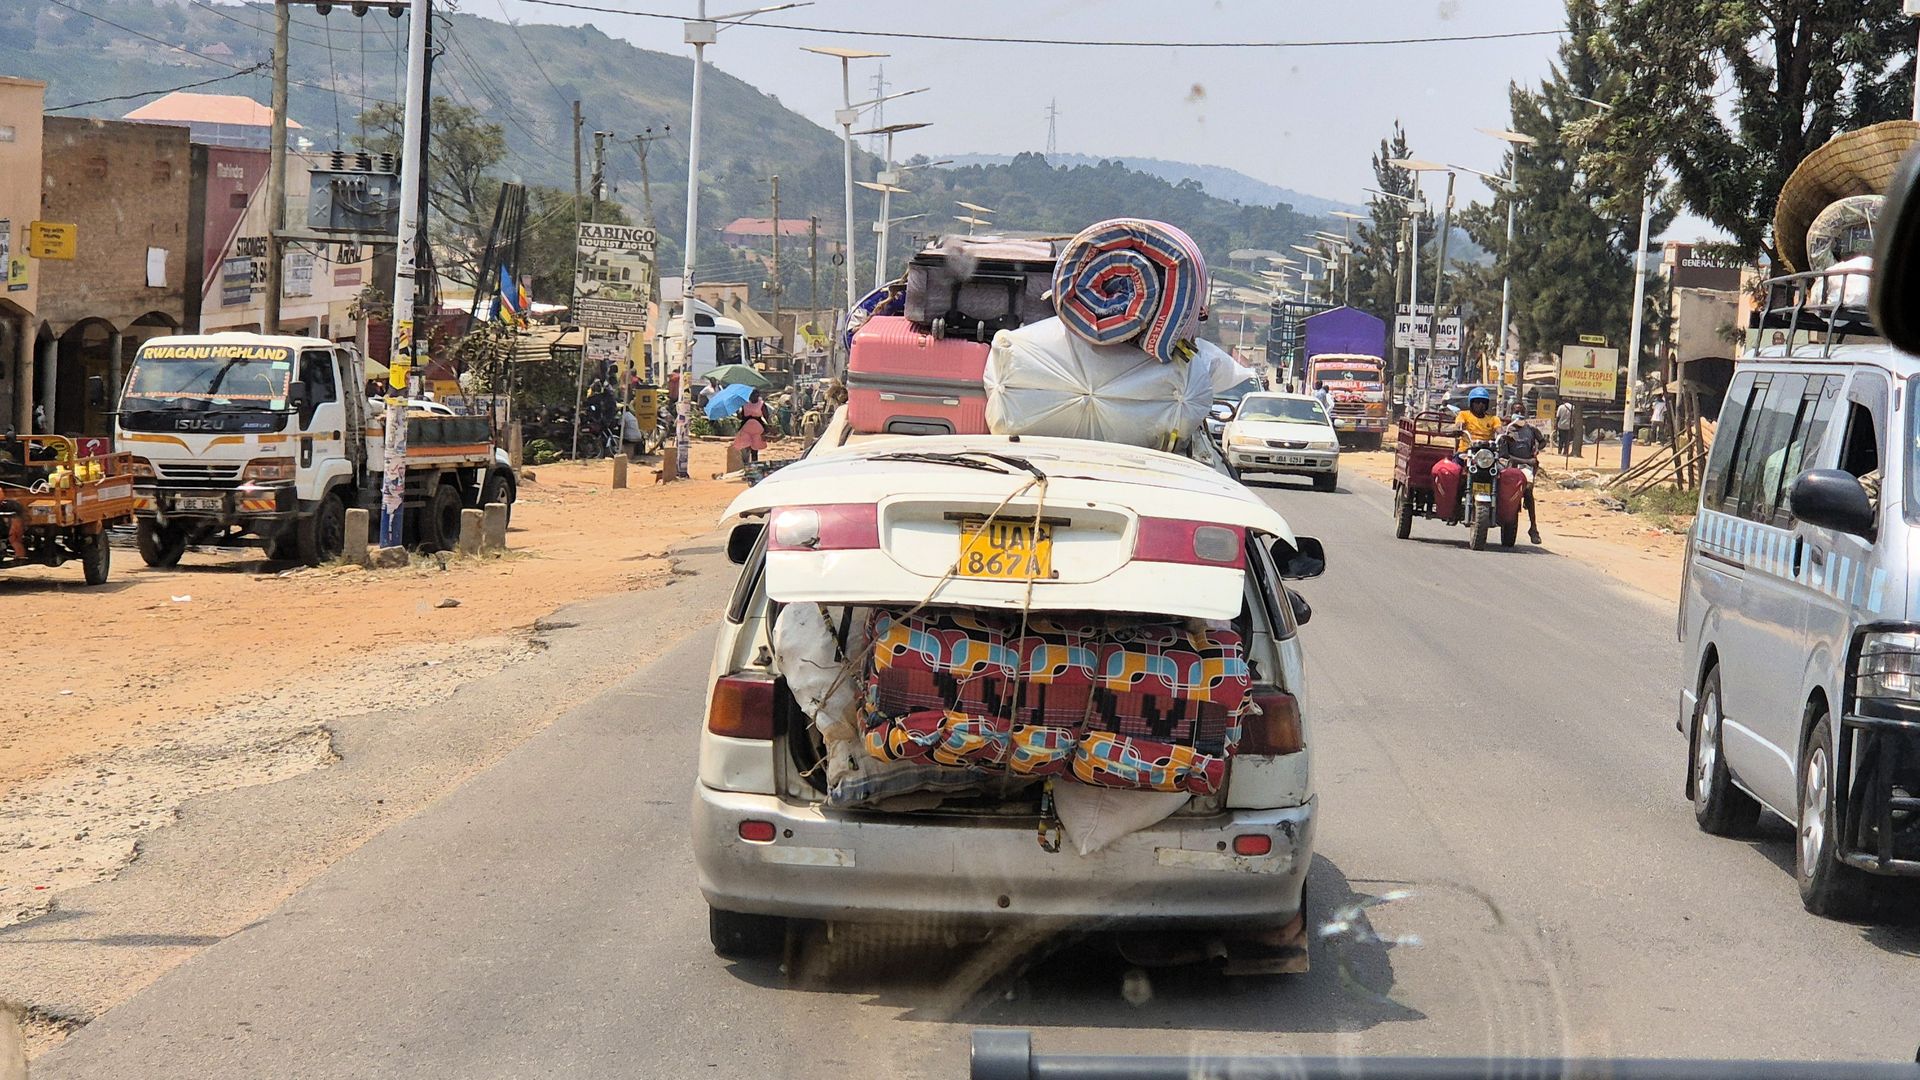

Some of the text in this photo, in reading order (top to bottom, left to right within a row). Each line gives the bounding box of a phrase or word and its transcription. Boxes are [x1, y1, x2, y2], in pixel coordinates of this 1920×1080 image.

[580, 225, 655, 242] KABINGO
[580, 238, 653, 251] TOURIST MOTEL
[1681, 259, 1715, 268] GENERAL
[1398, 304, 1411, 314] JEY
[1399, 322, 1411, 333] JEY
[211, 347, 288, 360] HIGHLAND
[1588, 371, 1613, 381] PEOPLES
[174, 419, 224, 430] ISUZU
[968, 551, 1041, 575] 867A
